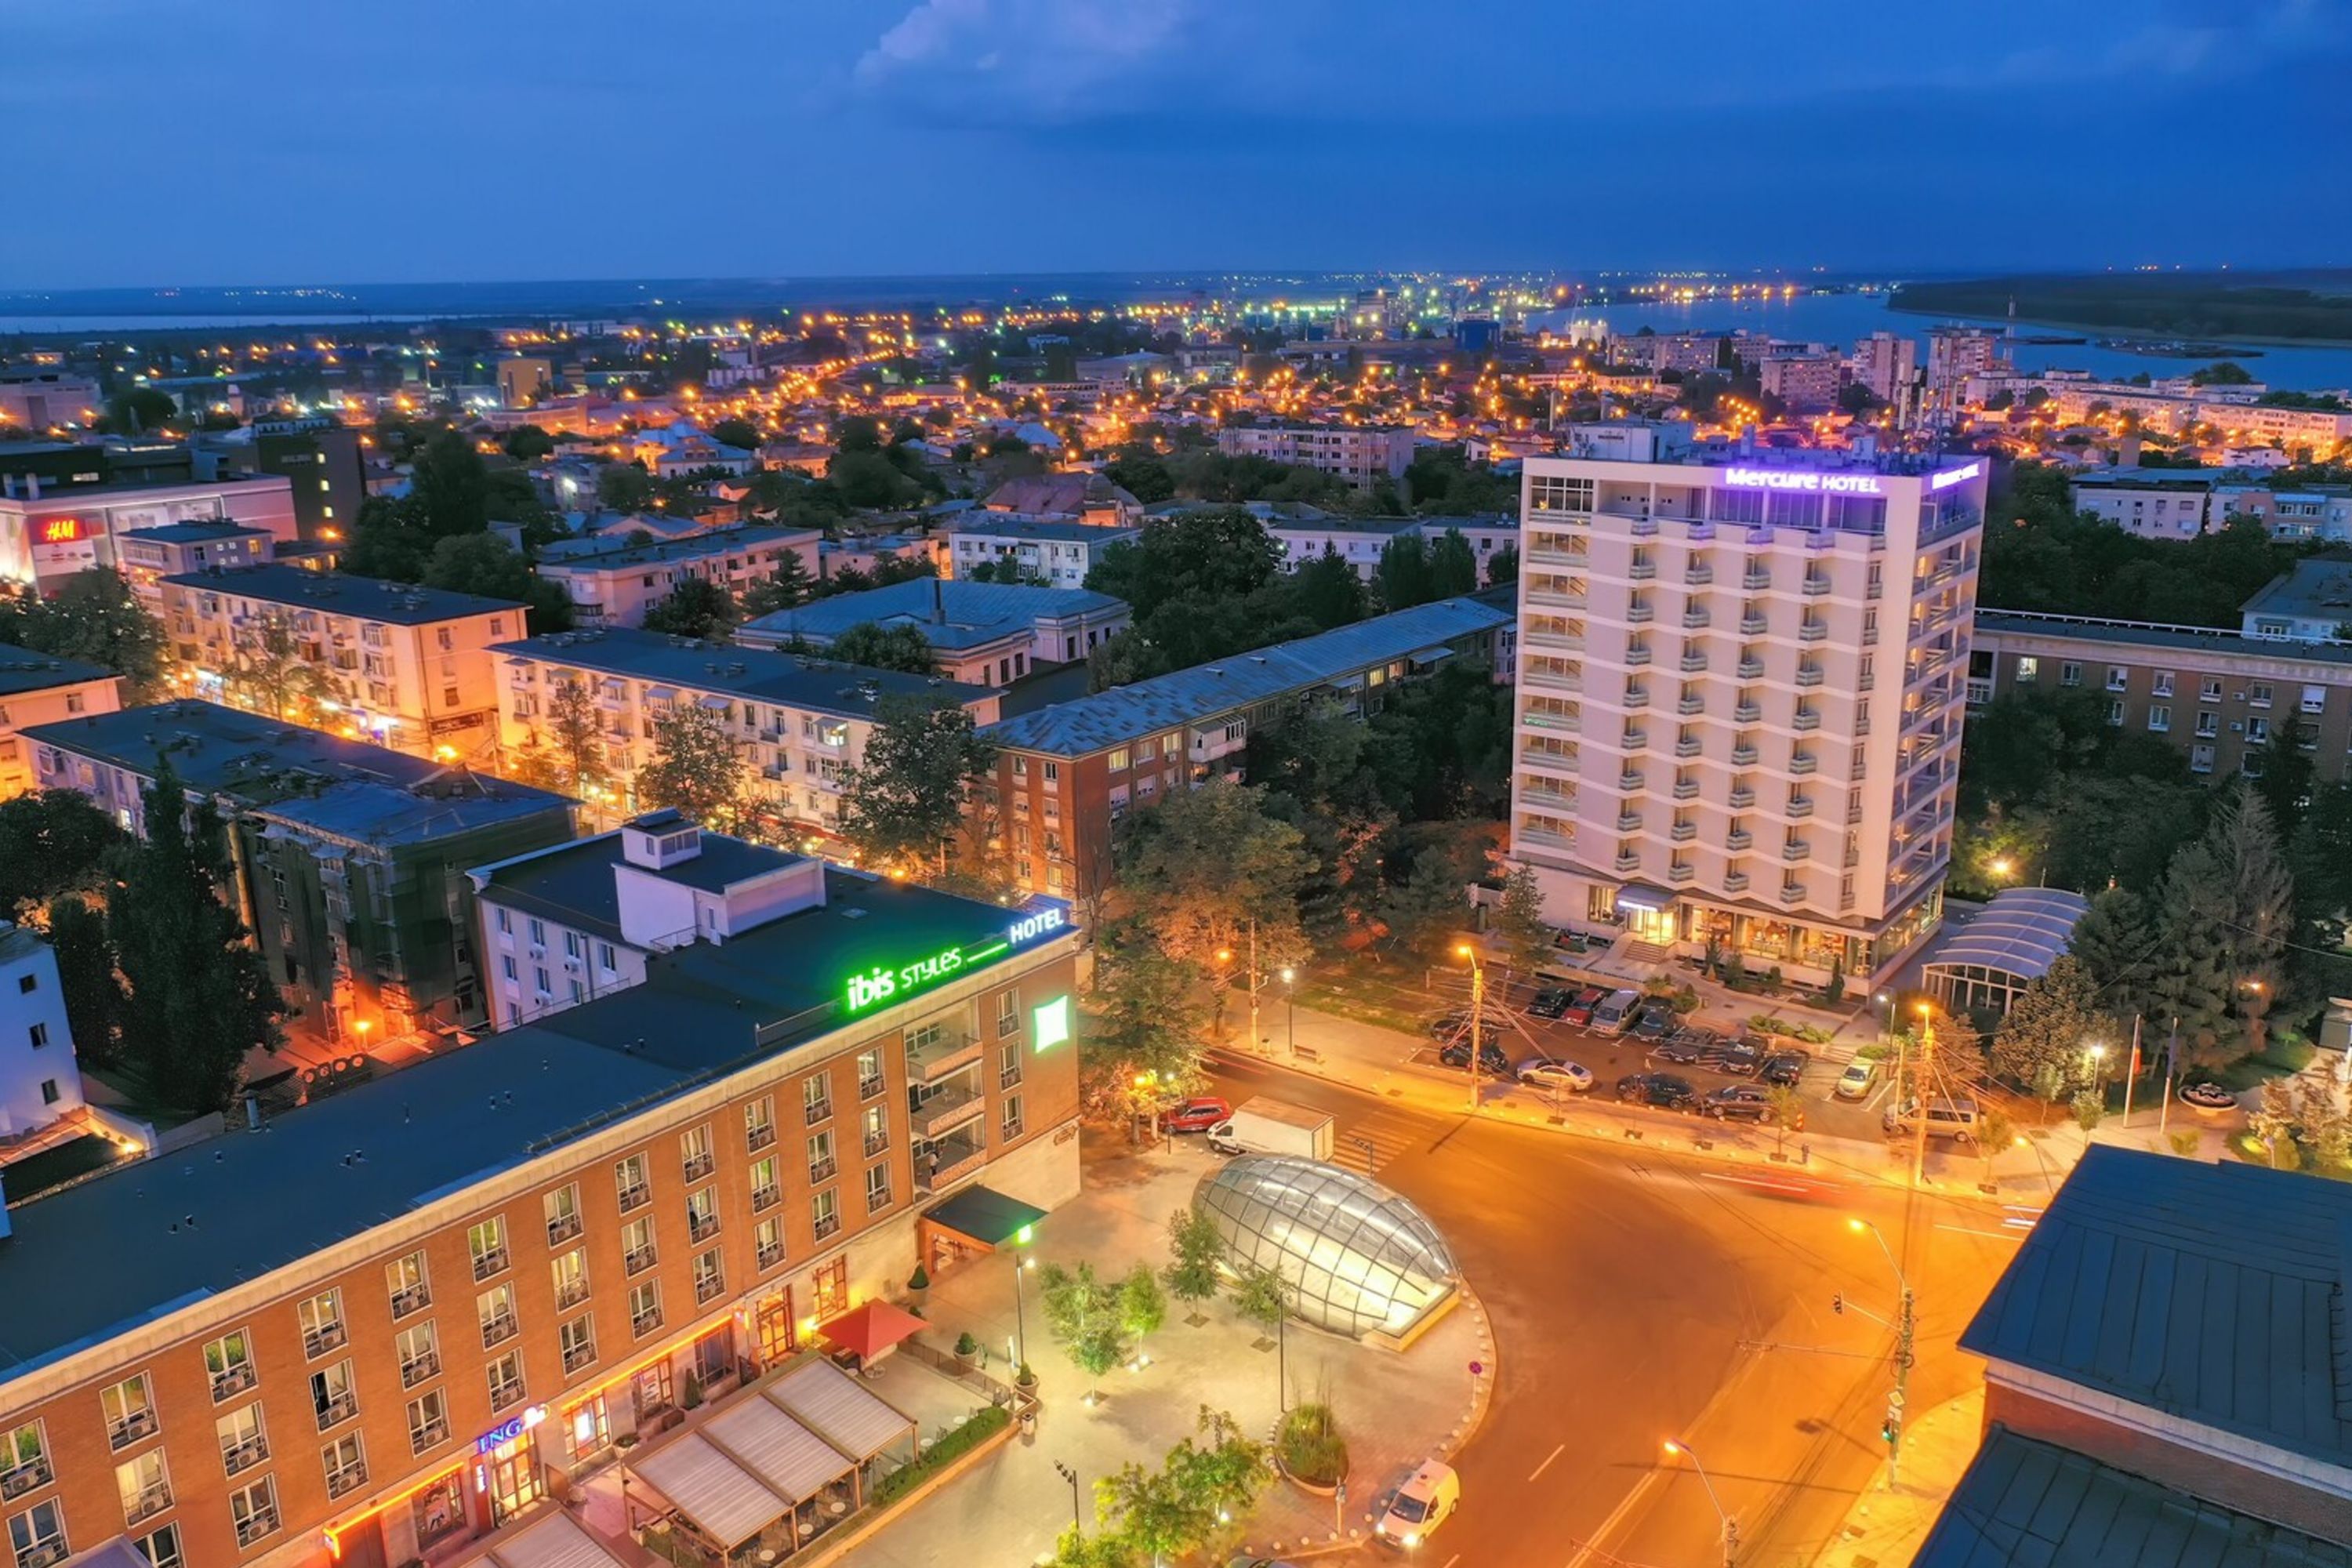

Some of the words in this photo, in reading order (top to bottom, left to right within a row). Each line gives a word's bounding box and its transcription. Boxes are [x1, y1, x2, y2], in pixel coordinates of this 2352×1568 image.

[1726, 468, 1820, 489] Mercure
[1821, 475, 1881, 492] HOTEL
[847, 967, 896, 1011] ibis
[1010, 907, 1065, 944] HOTEL
[477, 1418, 524, 1454] ING
